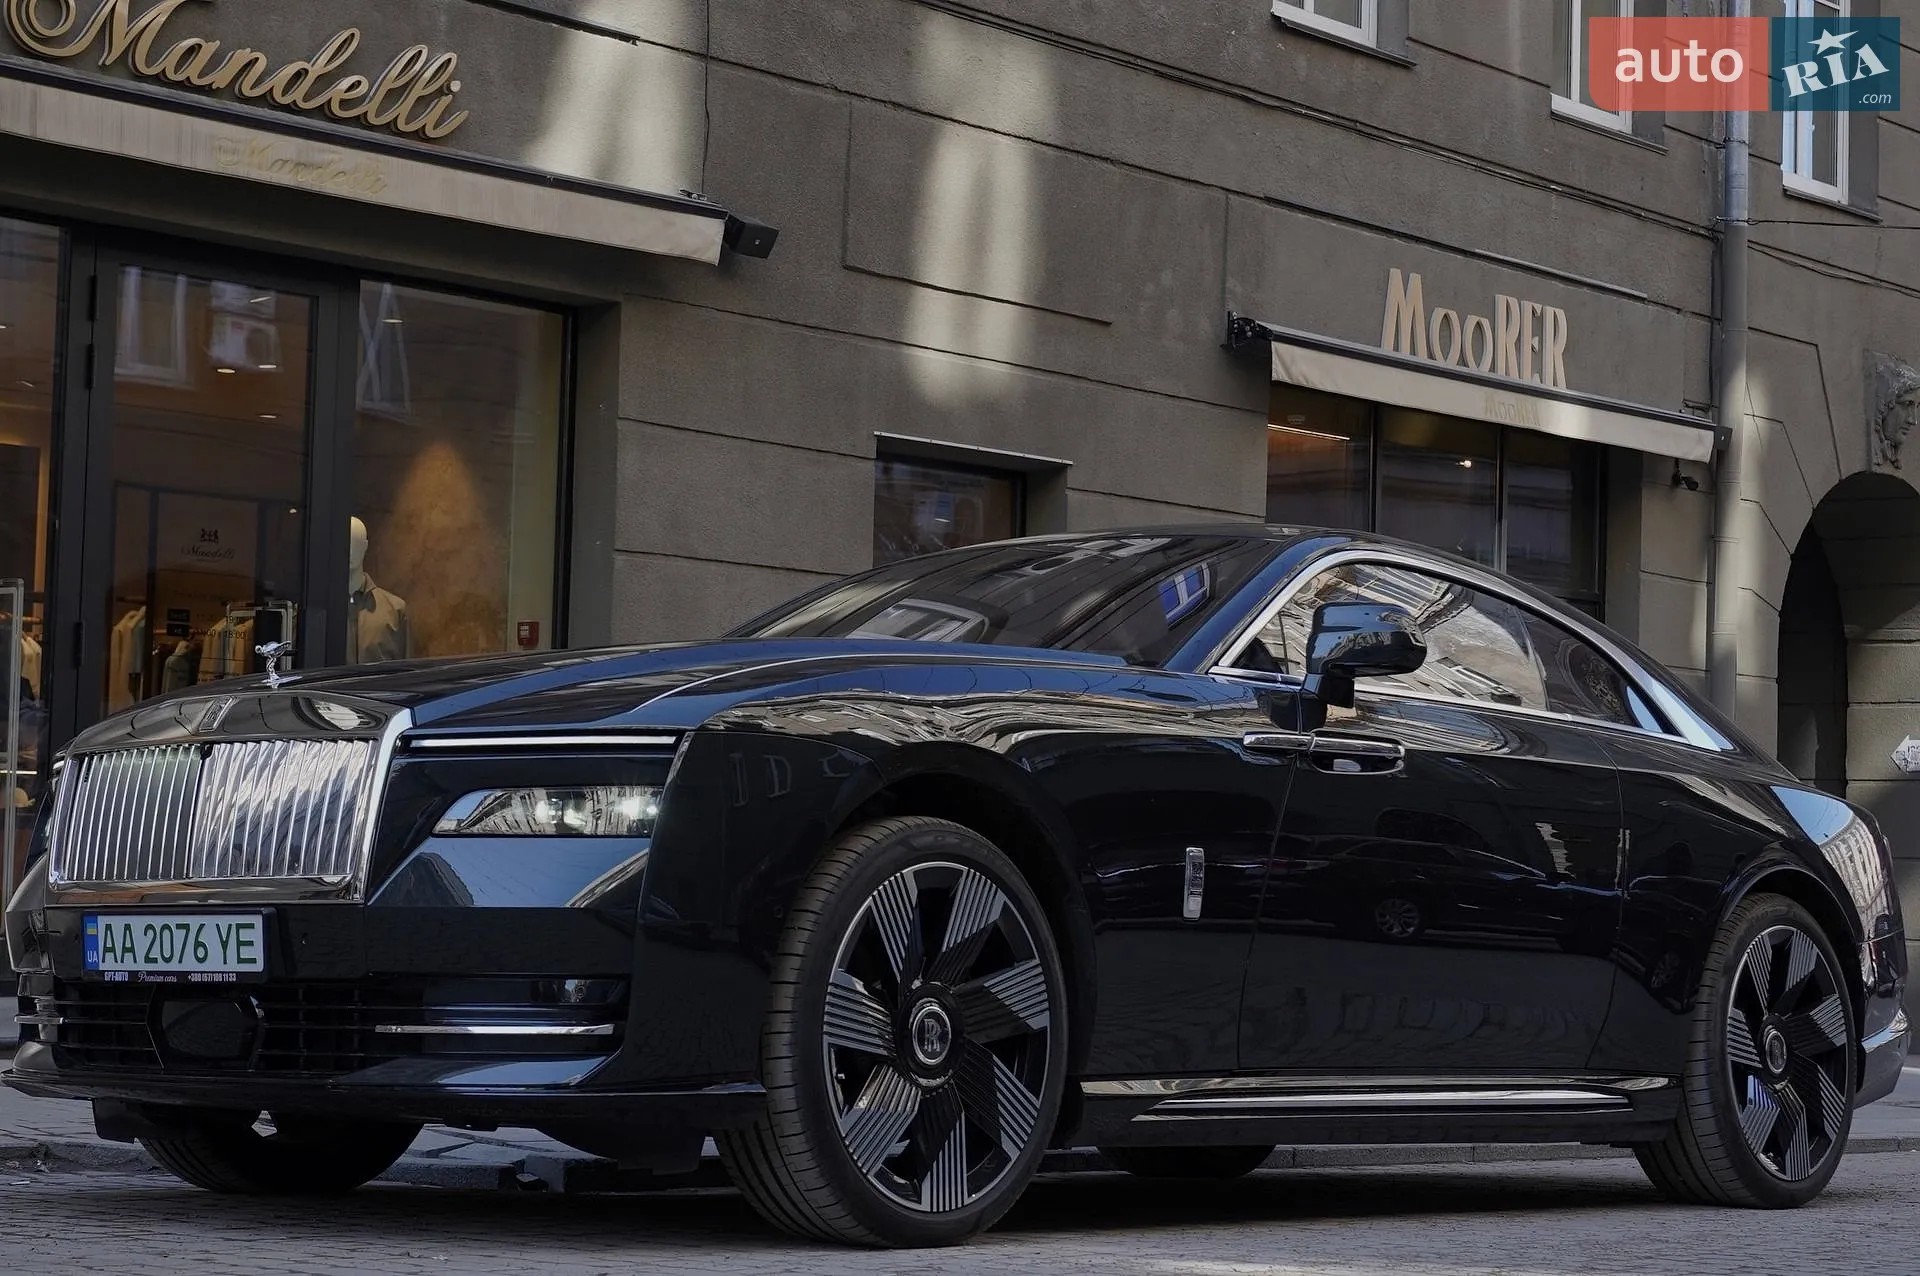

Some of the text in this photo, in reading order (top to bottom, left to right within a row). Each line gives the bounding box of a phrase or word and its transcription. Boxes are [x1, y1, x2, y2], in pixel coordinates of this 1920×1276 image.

[4, 0, 468, 138] Mandelli
[101, 923, 257, 964] AA 2076 YE
[87, 951, 98, 963] UA
[137, 971, 164, 982] Premium
